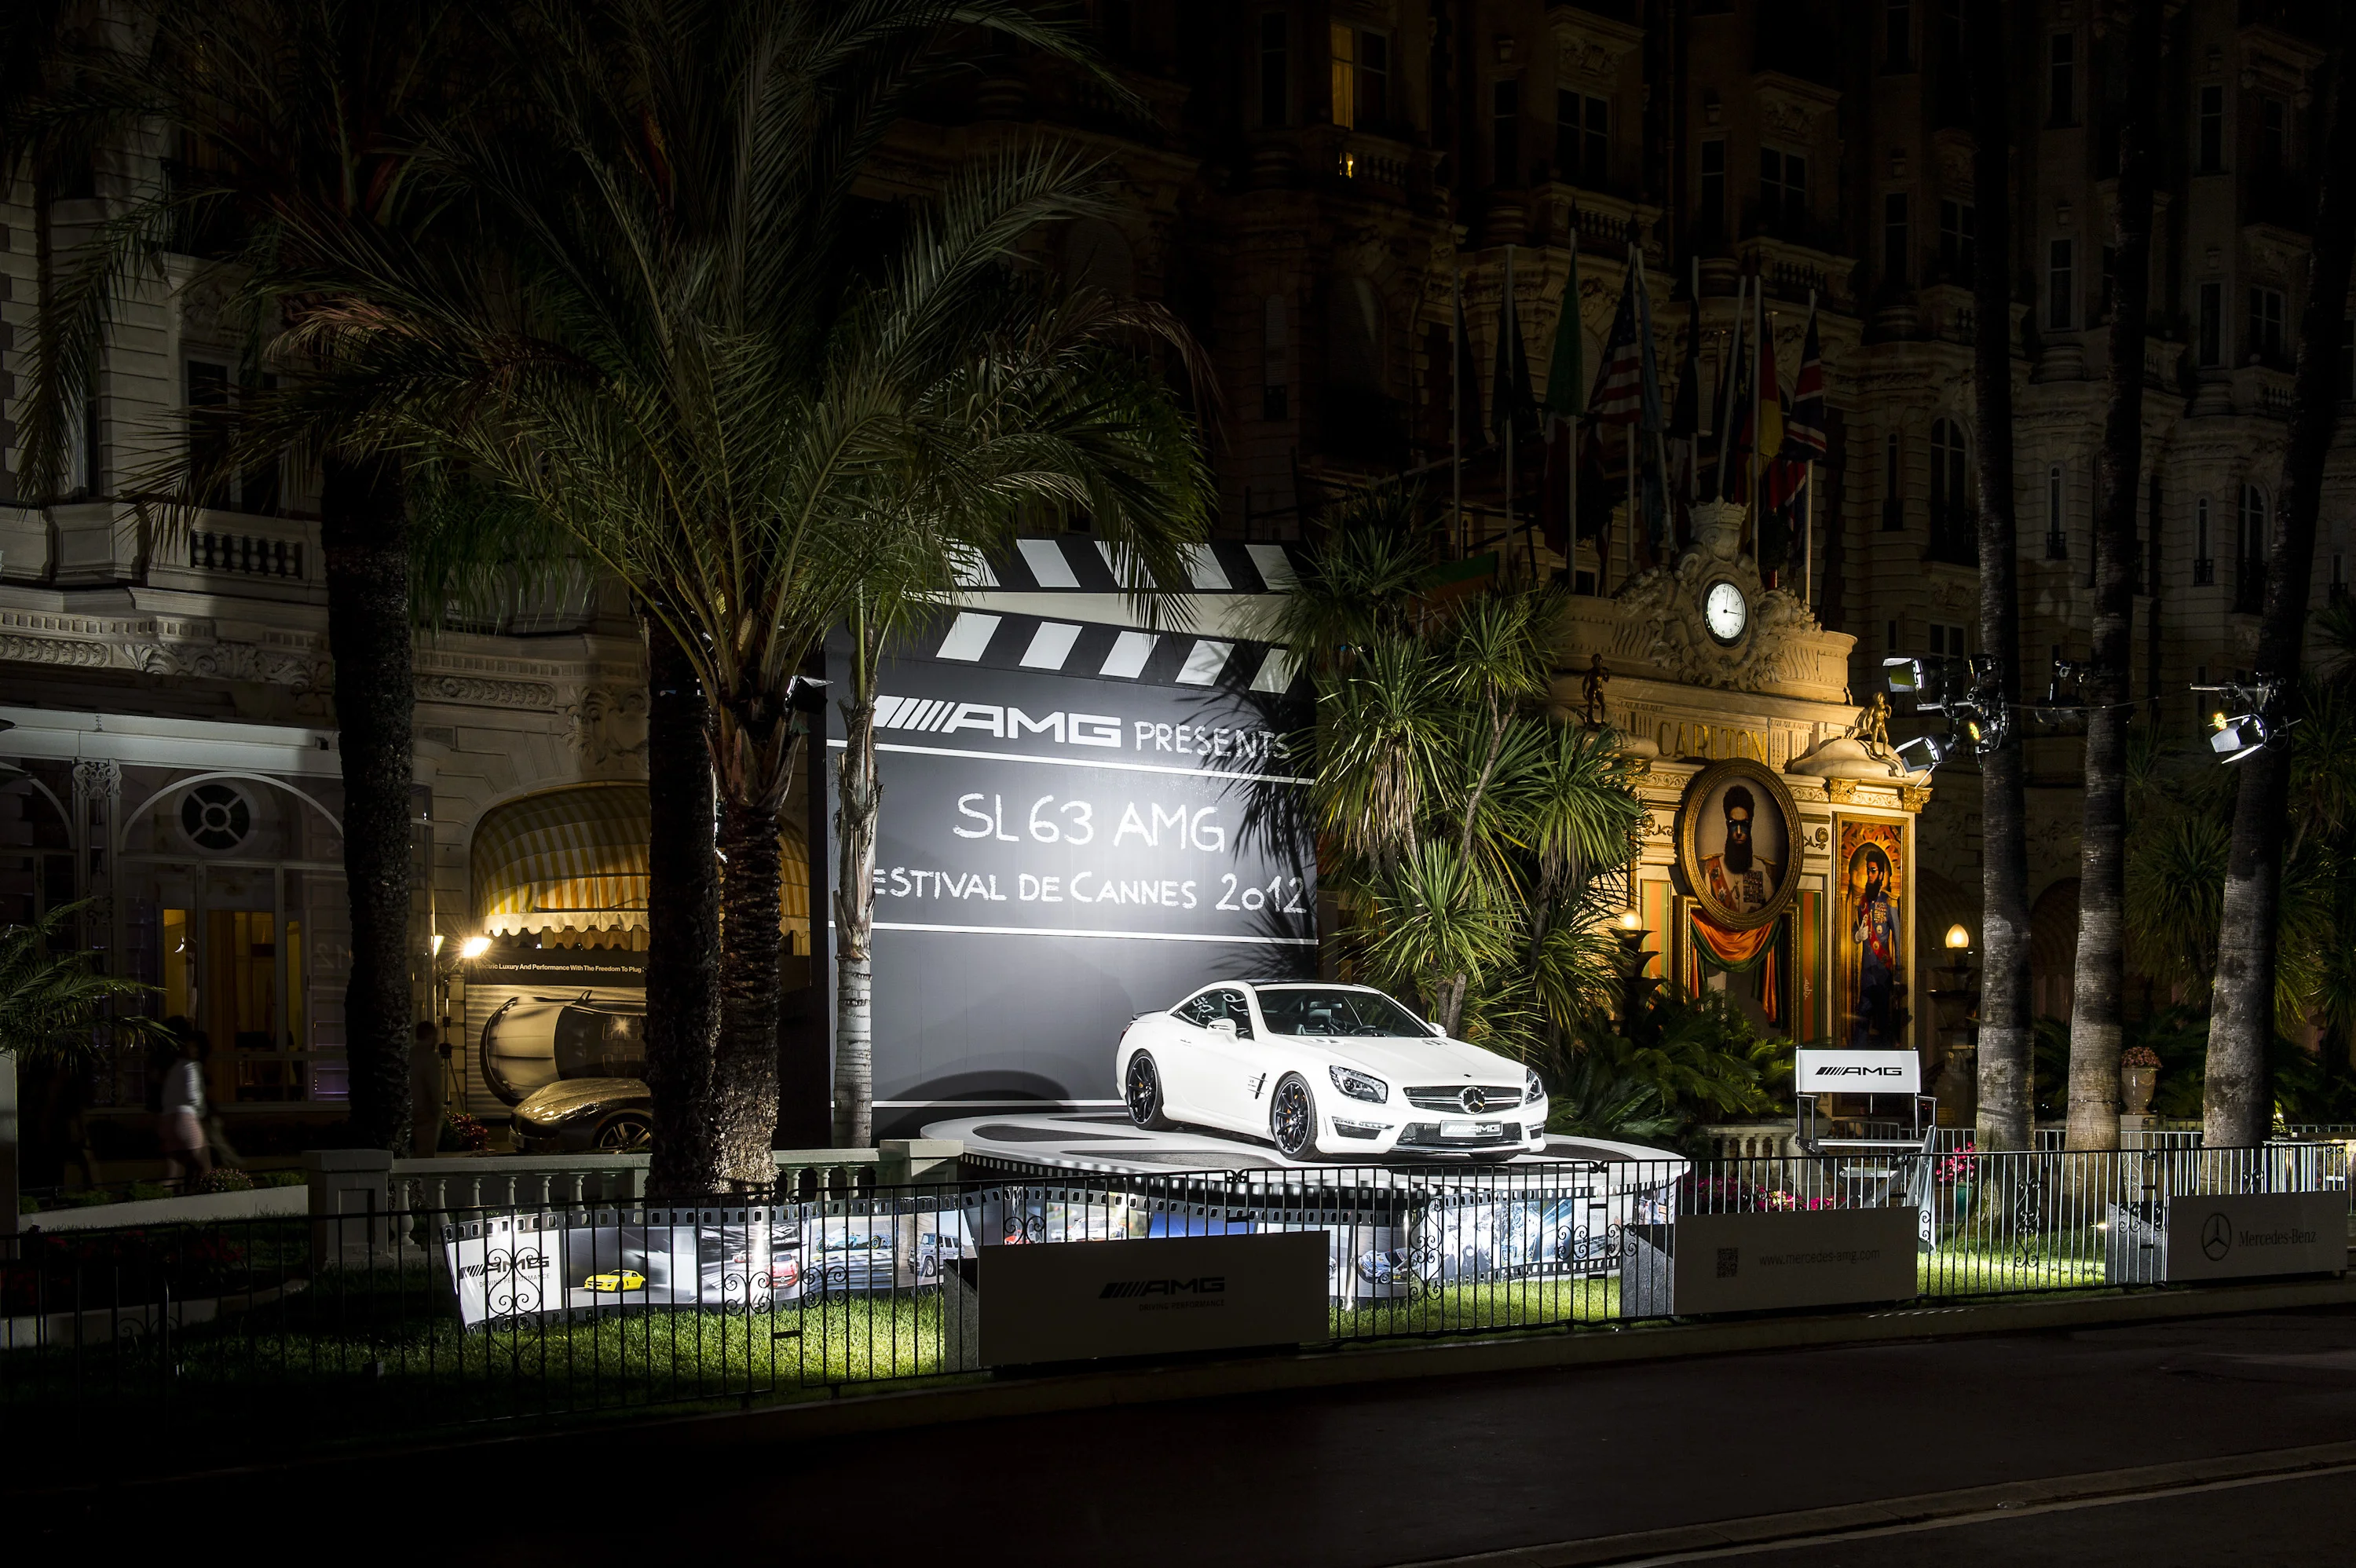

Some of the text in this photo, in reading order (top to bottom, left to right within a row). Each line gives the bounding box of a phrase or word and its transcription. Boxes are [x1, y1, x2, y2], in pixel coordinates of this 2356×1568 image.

[1134, 721, 1291, 758] PRESENTS
[1656, 720, 1766, 765] CARLTON
[952, 793, 1225, 853] SL 63 AMG
[873, 866, 1307, 913] ESTIVAL DE CANNES 2012
[1841, 1067, 1902, 1076] AMG
[2238, 1228, 2317, 1247] Mercedes-Benz
[1759, 1248, 1880, 1266] www.mercedes-amg.com
[1140, 1277, 1224, 1296] AMG
[1139, 1299, 1224, 1312] DRIVING PERFORMANCE
